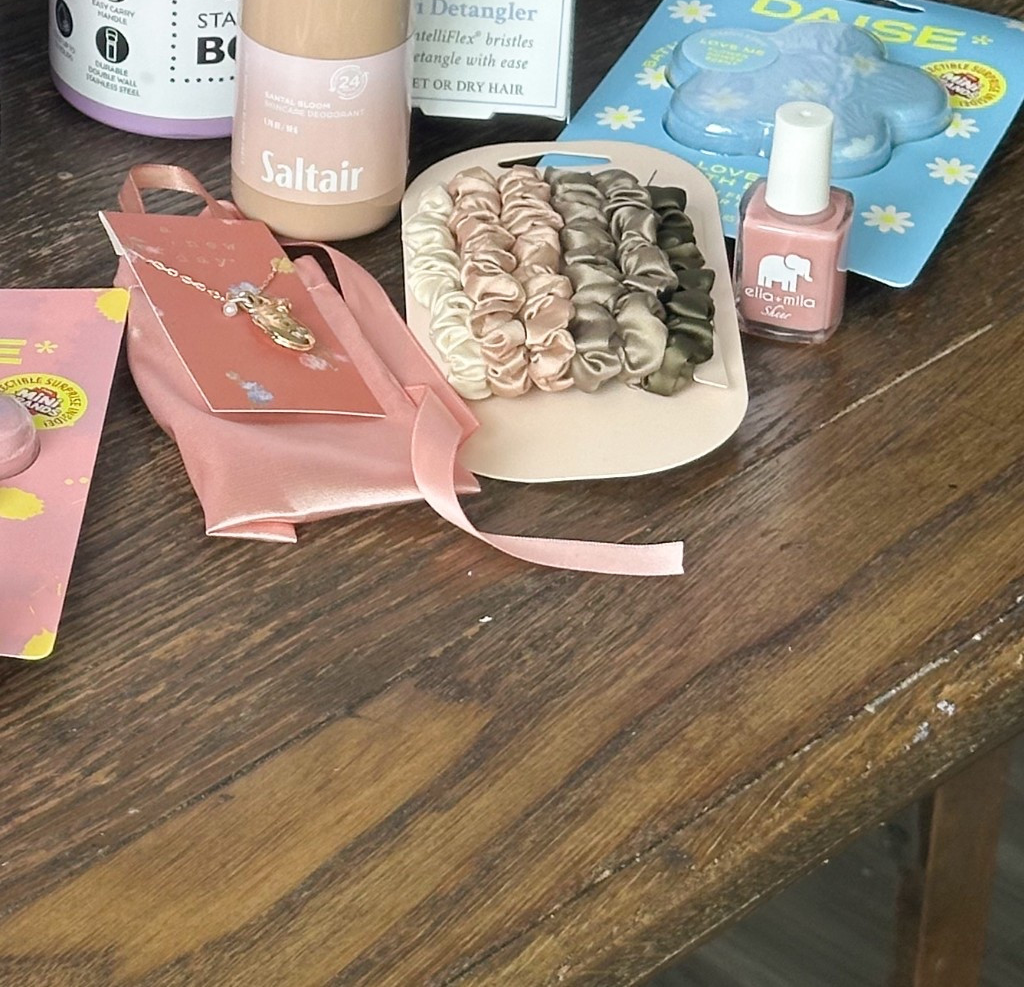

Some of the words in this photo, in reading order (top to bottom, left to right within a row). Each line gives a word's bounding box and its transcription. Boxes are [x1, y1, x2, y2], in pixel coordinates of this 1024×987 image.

[485, 32, 534, 49] bristles
[413, 50, 462, 69] etangle
[465, 53, 496, 68] with
[500, 59, 529, 70] ease
[338, 75, 361, 90] 24
[412, 77, 431, 90] ET
[433, 79, 453, 91] OR
[456, 80, 486, 93] DRY
[488, 82, 524, 96] HAIR
[297, 100, 331, 110] BLOOM
[260, 149, 364, 193] Saltair
[15, 387, 64, 408] MINI
